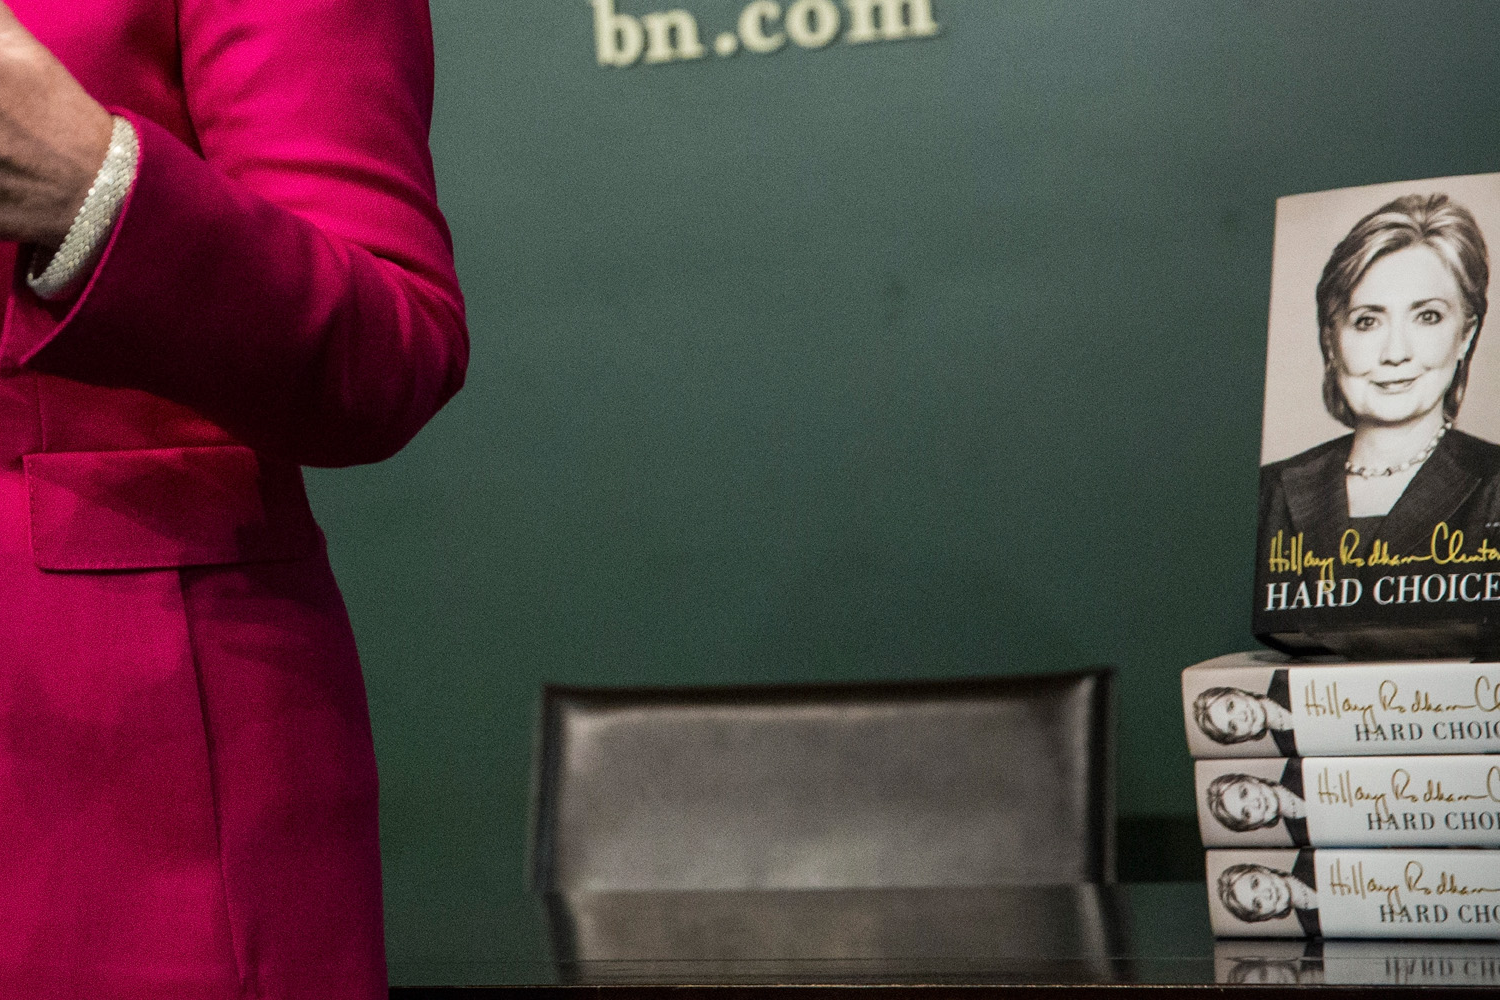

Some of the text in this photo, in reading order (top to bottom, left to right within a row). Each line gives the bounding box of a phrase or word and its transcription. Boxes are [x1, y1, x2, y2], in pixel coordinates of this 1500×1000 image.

[1269, 521, 1500, 592] Hillary Rodham Clinto
[1264, 571, 1500, 612] HARD CHOICE
[1304, 679, 1377, 734] Hillary
[1379, 679, 1475, 713] Rodham
[1355, 721, 1423, 742] HARD
[1317, 766, 1390, 824] Hillary
[1390, 768, 1488, 803] Rodham
[1367, 811, 1435, 831] HARD
[1329, 858, 1402, 917] Hillary
[1380, 904, 1449, 924] HARD
